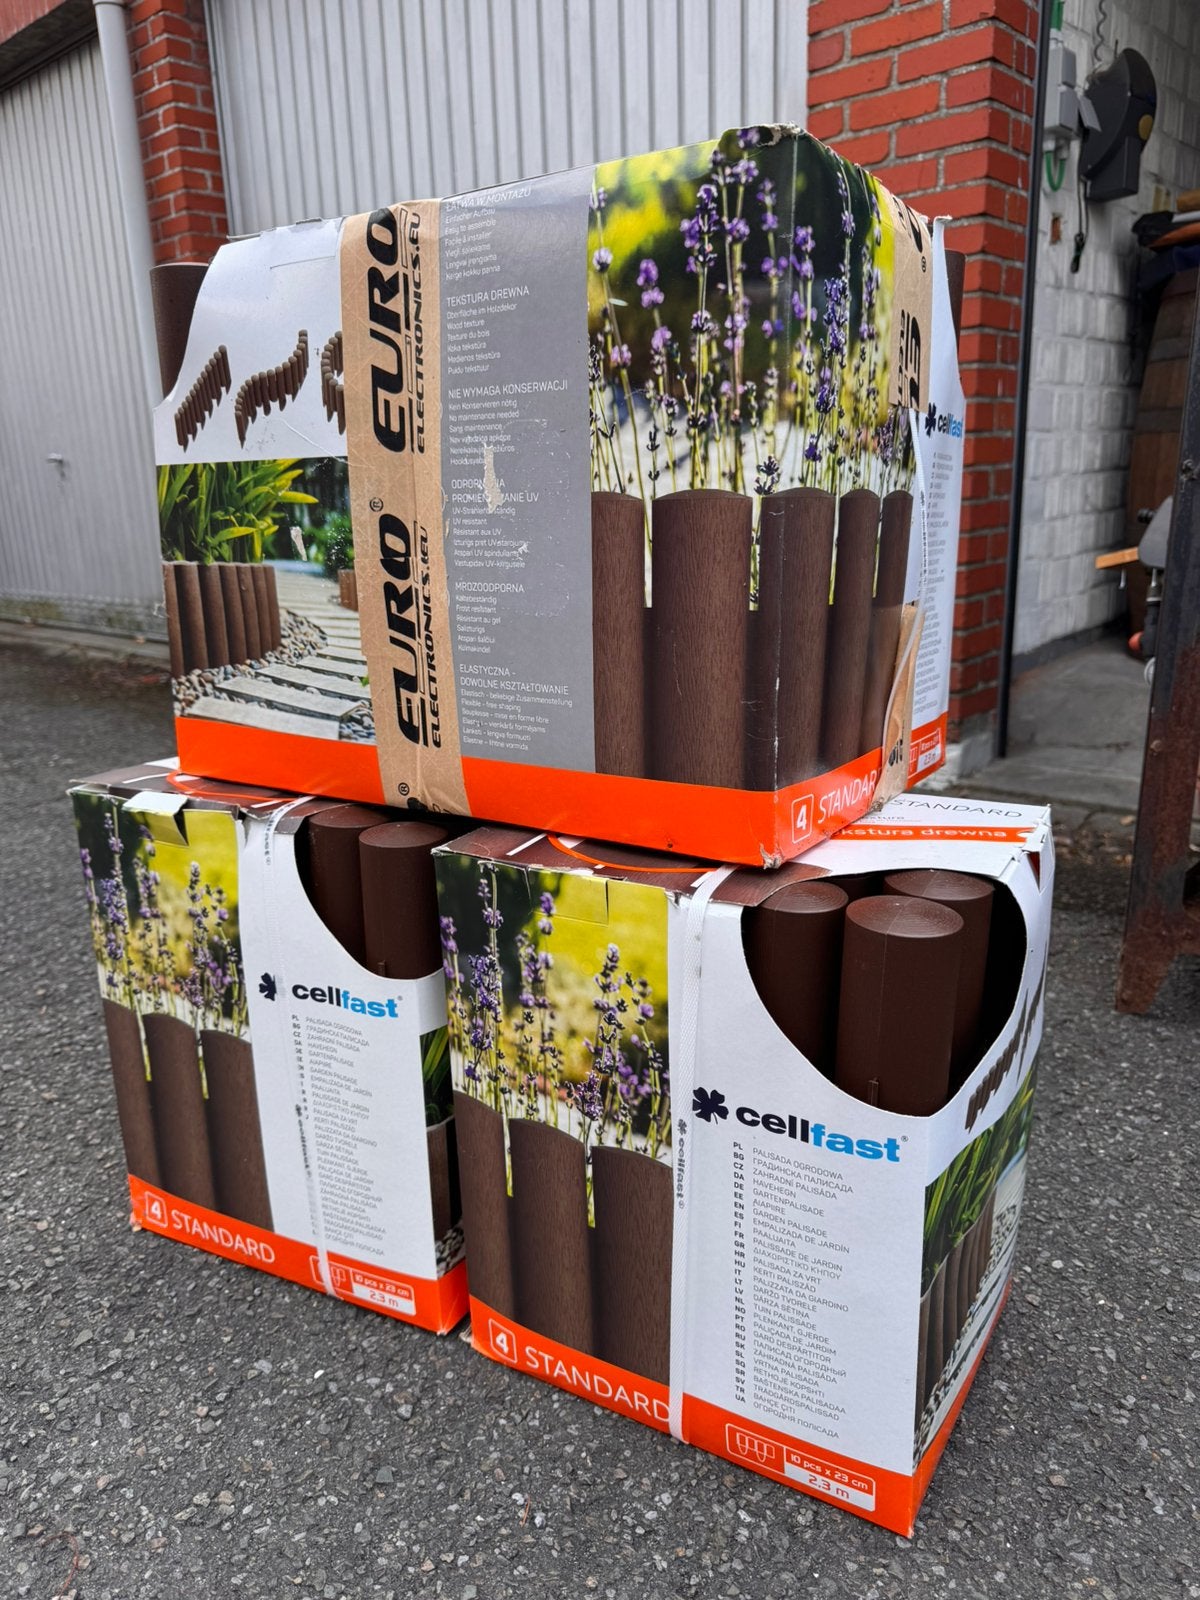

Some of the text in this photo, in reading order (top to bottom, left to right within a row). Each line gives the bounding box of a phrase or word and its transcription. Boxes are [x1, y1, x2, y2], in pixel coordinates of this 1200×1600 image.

[447, 286, 530, 307] TEKSTURA DREWNA
[367, 207, 406, 453] EURO
[408, 212, 425, 454] ELECTRONICS.EU
[448, 380, 568, 399] NIE WYMAGA KONSERWACJI
[526, 492, 540, 503] UV
[455, 581, 525, 593] MROZOODPORNA
[379, 513, 421, 745] EURO
[420, 526, 442, 749] ELECTRONICS.EU
[460, 663, 511, 677] ELASTYCZNA
[460, 676, 569, 695] DOWOLNE KSZTAŁTOWANIE
[795, 767, 882, 831] 4 STANDAR
[892, 798, 1023, 819] STANDARD
[838, 826, 1007, 838] kstura drewna
[733, 1141, 743, 1151] PL
[733, 1151, 744, 1161] BG
[733, 1161, 744, 1170] CZ
[753, 1147, 844, 1181] PALISADA OGRODOWA
[734, 1171, 745, 1181] DA
[734, 1181, 744, 1191] DE
[753, 1178, 797, 1198] HAVEHEGN
[803, 1173, 854, 1194] ПАЛИСАДА
[734, 1191, 744, 1200] EE
[753, 1187, 825, 1217] GARTENPALISADE
[734, 1201, 745, 1210] EN
[734, 1211, 744, 1220] ES
[734, 1220, 742, 1229] FI
[753, 1208, 828, 1238] GARDEN PALISADE
[150, 1200, 276, 1265] 4 STANDARD
[734, 1230, 745, 1239] FR
[753, 1217, 803, 1240] EMPALIZADA
[804, 1235, 817, 1246] DE
[753, 1227, 797, 1248] PAALUAITA
[734, 1240, 745, 1249] GR
[734, 1250, 746, 1259] HR
[753, 1236, 843, 1272] PALISSADE DE JARDIN
[734, 1259, 746, 1268] HU
[734, 1268, 742, 1276] IT
[753, 1256, 823, 1286] PALISADA ZA VRT
[753, 1265, 776, 1280] KERTI
[734, 1277, 743, 1286] LT
[734, 1287, 744, 1296] LV
[753, 1275, 849, 1313] PALIZZATA DA GIARDINO
[388, 1296, 399, 1308] m
[734, 1296, 745, 1305] NL
[735, 1305, 746, 1314] NO
[735, 1313, 745, 1323] PT
[753, 1302, 818, 1332] TUIN PALISSADE
[735, 1322, 746, 1332] RO
[735, 1331, 746, 1341] RU
[753, 1330, 776, 1344] GARD
[797, 1328, 830, 1345] GJERDE
[735, 1340, 746, 1350] SK
[792, 1335, 804, 1346] DE
[804, 1340, 837, 1356] JARDIM
[735, 1349, 745, 1359] SL
[735, 1358, 746, 1368] SQ
[494, 1330, 670, 1423] 4 STANDARD
[735, 1367, 746, 1377] SR
[753, 1357, 820, 1388] VRTNA PALISADA
[735, 1376, 746, 1386] SV
[735, 1385, 746, 1394] TR
[790, 1380, 825, 1399] KOPSHTI
[735, 1394, 747, 1404] UA
[800, 1393, 847, 1415] PALISADAA
[790, 1452, 800, 1463] 10
[803, 1457, 822, 1473] pcs
[834, 1470, 849, 1484] 23
[851, 1477, 869, 1491] cm
[808, 1473, 850, 1500] 2.3 m
